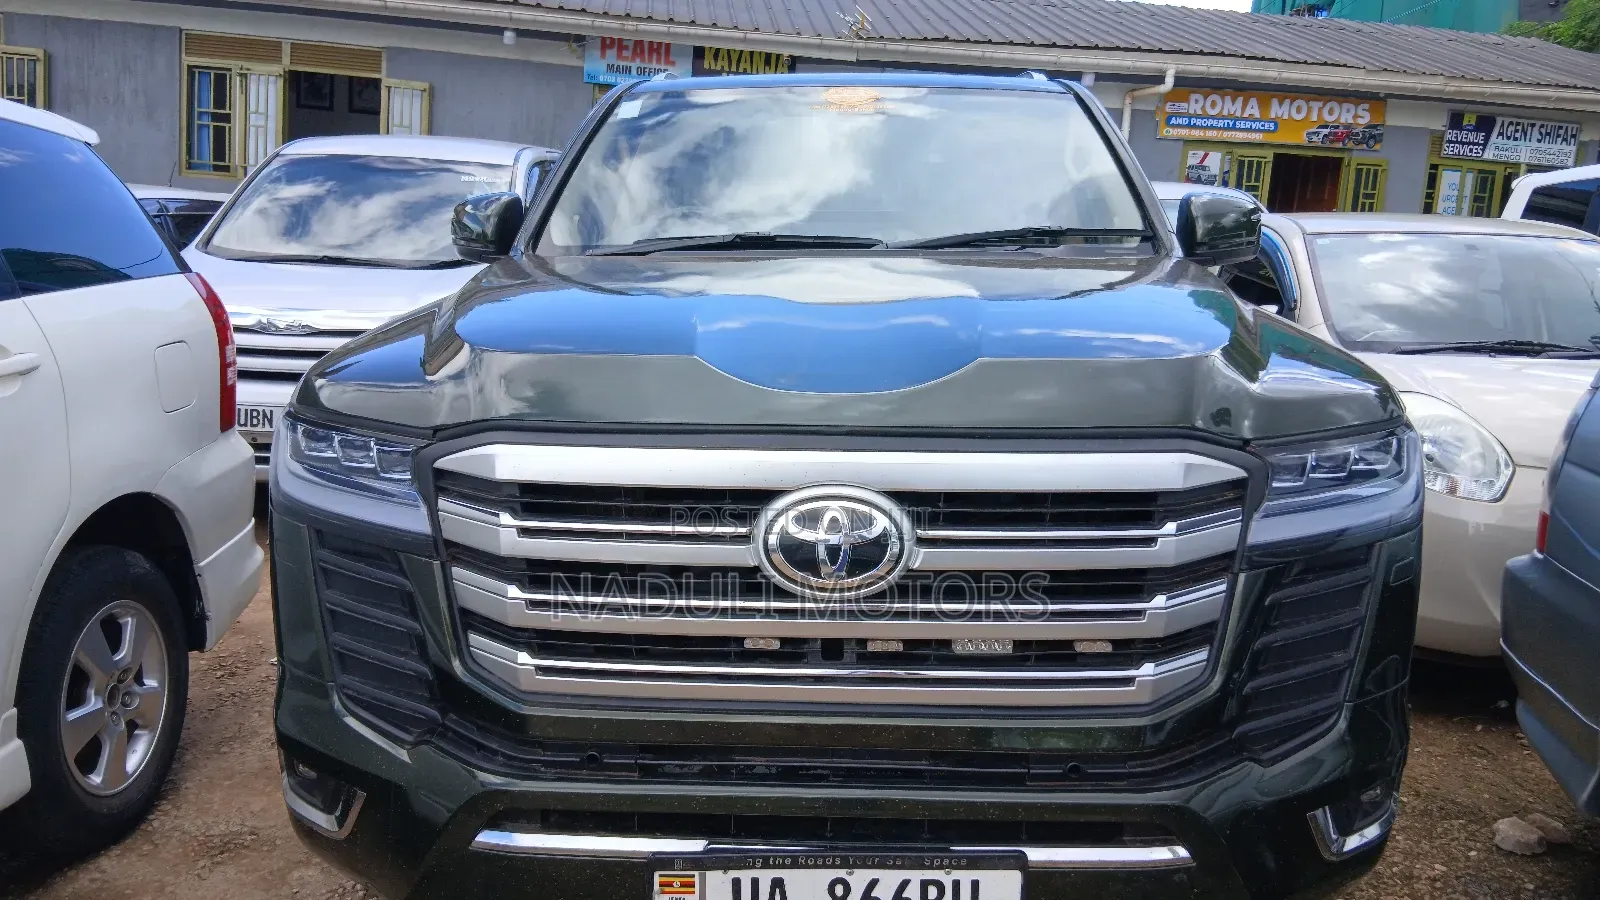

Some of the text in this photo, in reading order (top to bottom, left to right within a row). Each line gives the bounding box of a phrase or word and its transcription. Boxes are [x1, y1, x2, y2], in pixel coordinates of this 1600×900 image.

[600, 36, 676, 67] PEARL
[703, 46, 789, 74] KAYANJA
[606, 63, 632, 76] MAIN
[1188, 93, 1371, 125] ROMA MOTORS
[1170, 116, 1275, 131] AND PROPERTY SERVICES
[1446, 129, 1486, 144] REVENUE
[1496, 120, 1579, 147] AGENT SHIFAH
[1443, 143, 1483, 157] SERVICES
[1491, 152, 1521, 161] MENGO
[236, 407, 274, 429] UBN
[770, 856, 792, 865] the
[799, 857, 841, 865] Roads
[924, 857, 967, 868] Space
